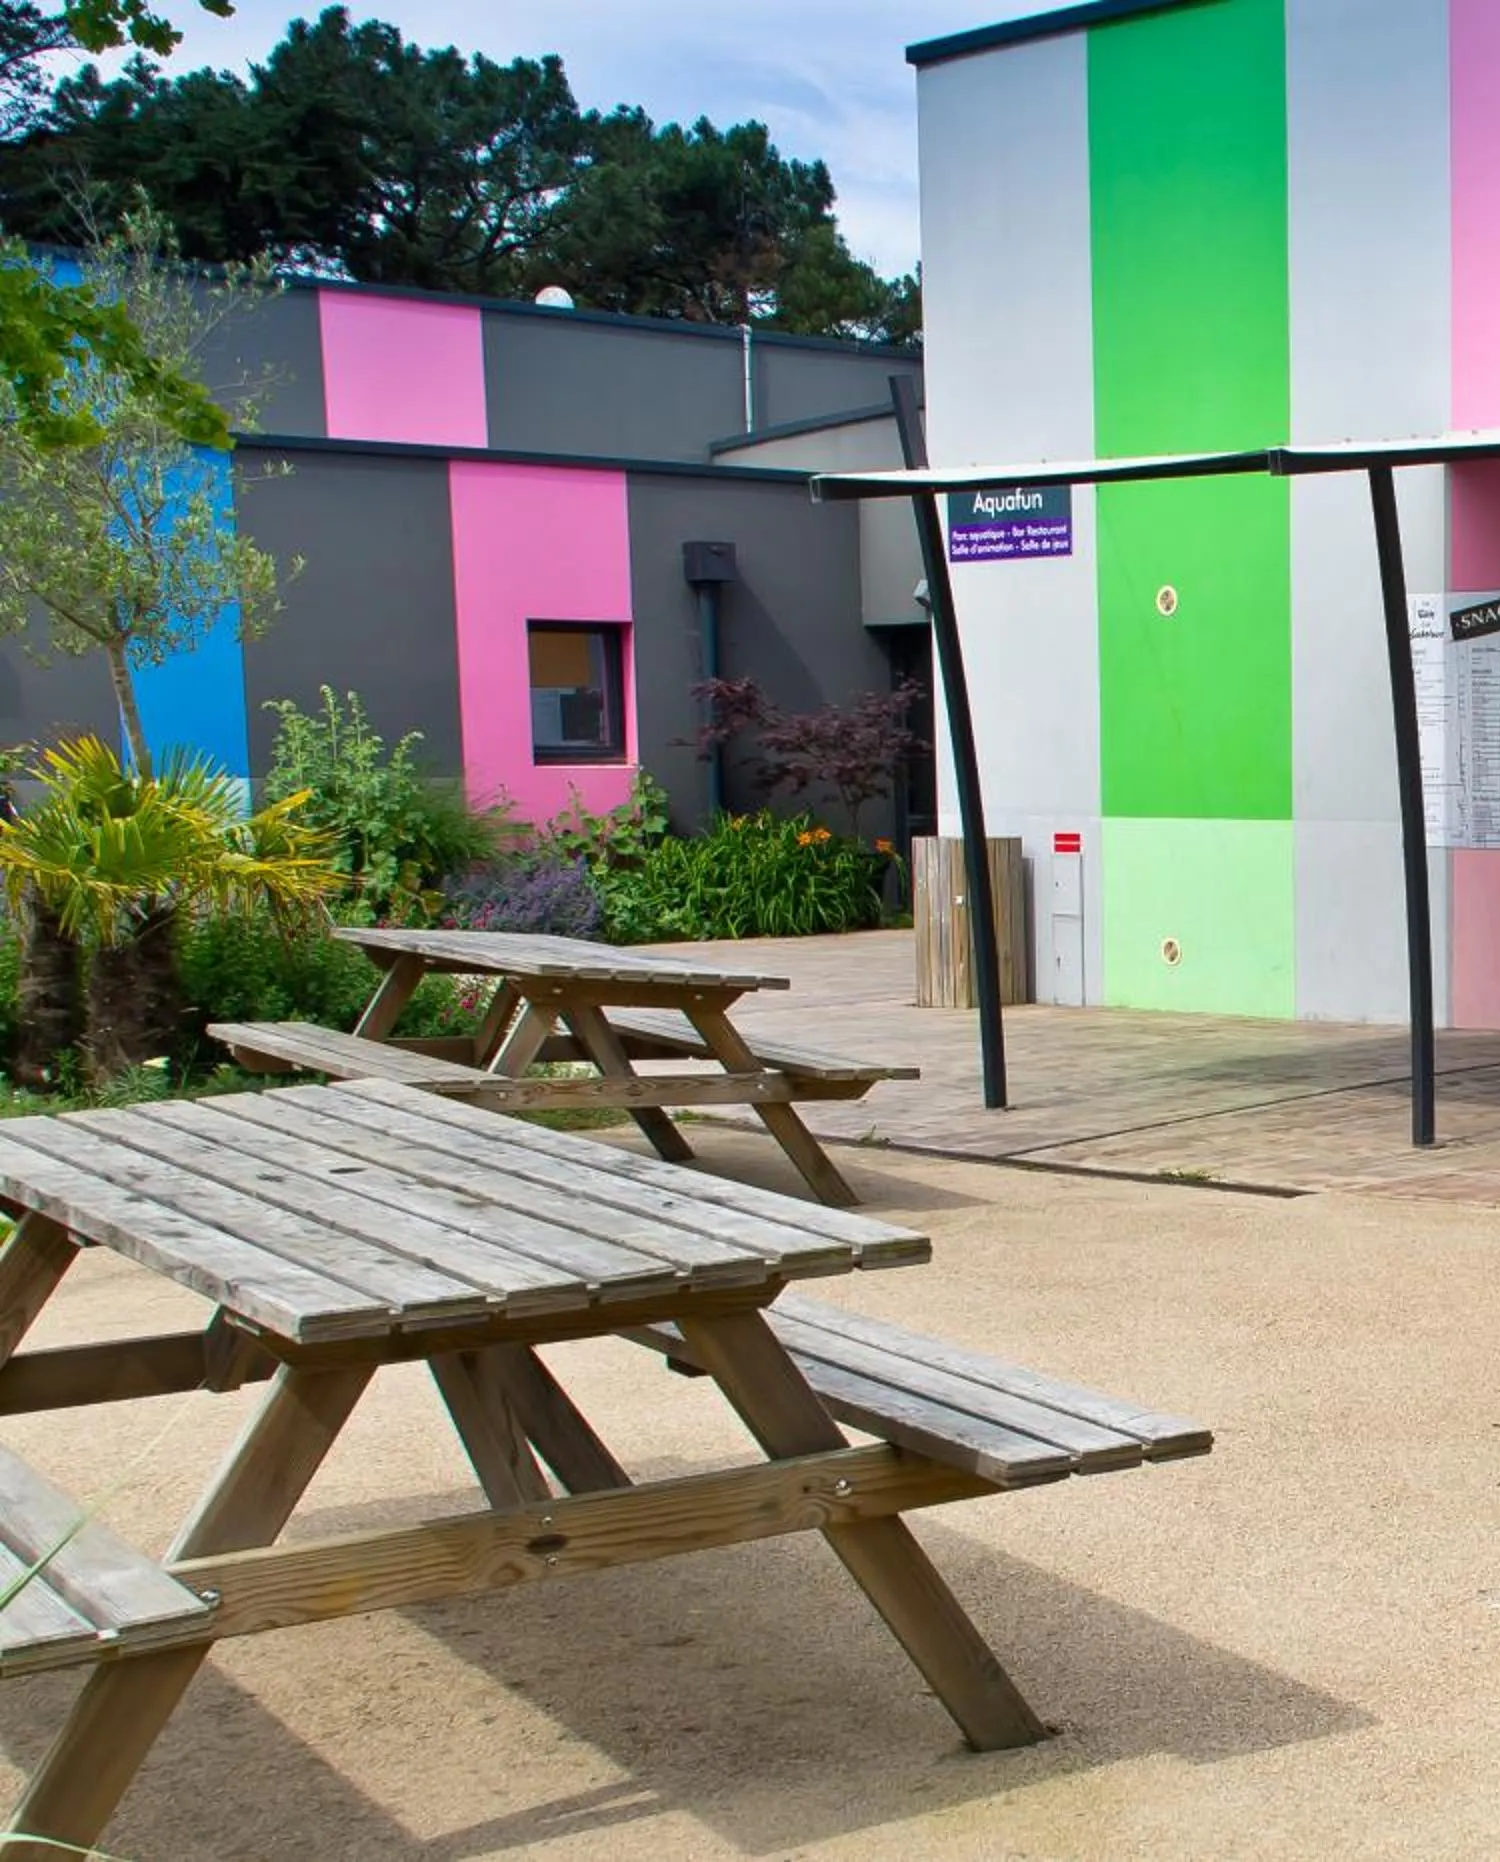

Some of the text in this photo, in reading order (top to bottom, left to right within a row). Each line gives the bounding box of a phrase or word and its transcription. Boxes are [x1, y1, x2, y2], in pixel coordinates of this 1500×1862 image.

[973, 487, 1043, 519] Aquafun
[1012, 525, 1025, 537] Bar
[1027, 525, 1067, 536] Restaurant
[952, 544, 969, 555] Salle
[1021, 539, 1039, 551] Salle
[1042, 538, 1051, 549] de
